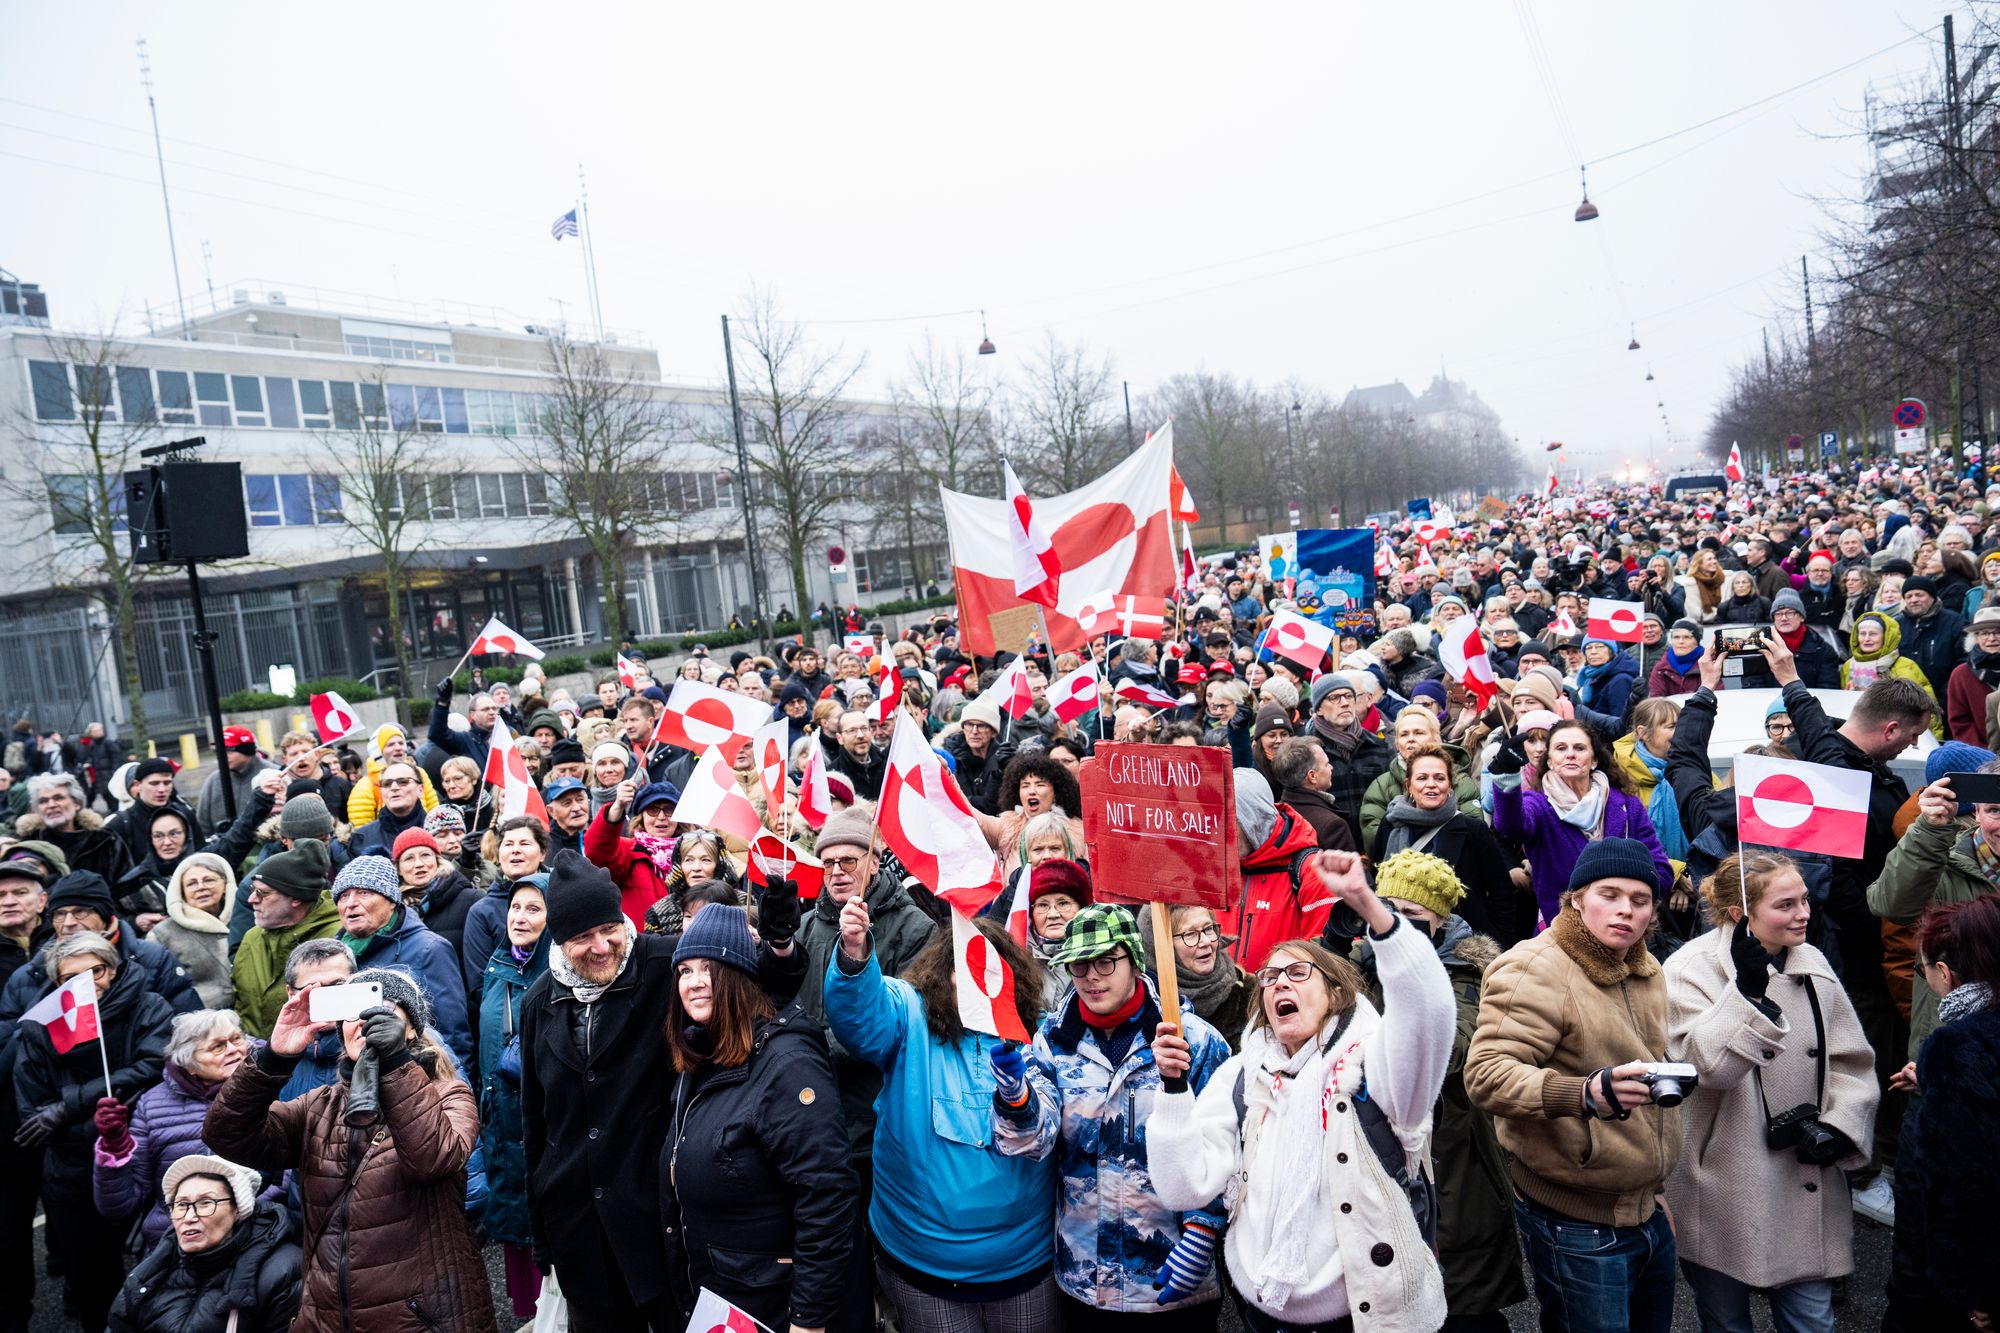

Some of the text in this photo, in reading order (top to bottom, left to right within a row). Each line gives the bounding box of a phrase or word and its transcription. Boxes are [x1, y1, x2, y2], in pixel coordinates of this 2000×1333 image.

[1824, 434, 1834, 446] P
[1109, 752, 1201, 788] GREENLAND
[1106, 799, 1219, 835] NOT FOR SALE!
[1256, 900, 1270, 910] HH
